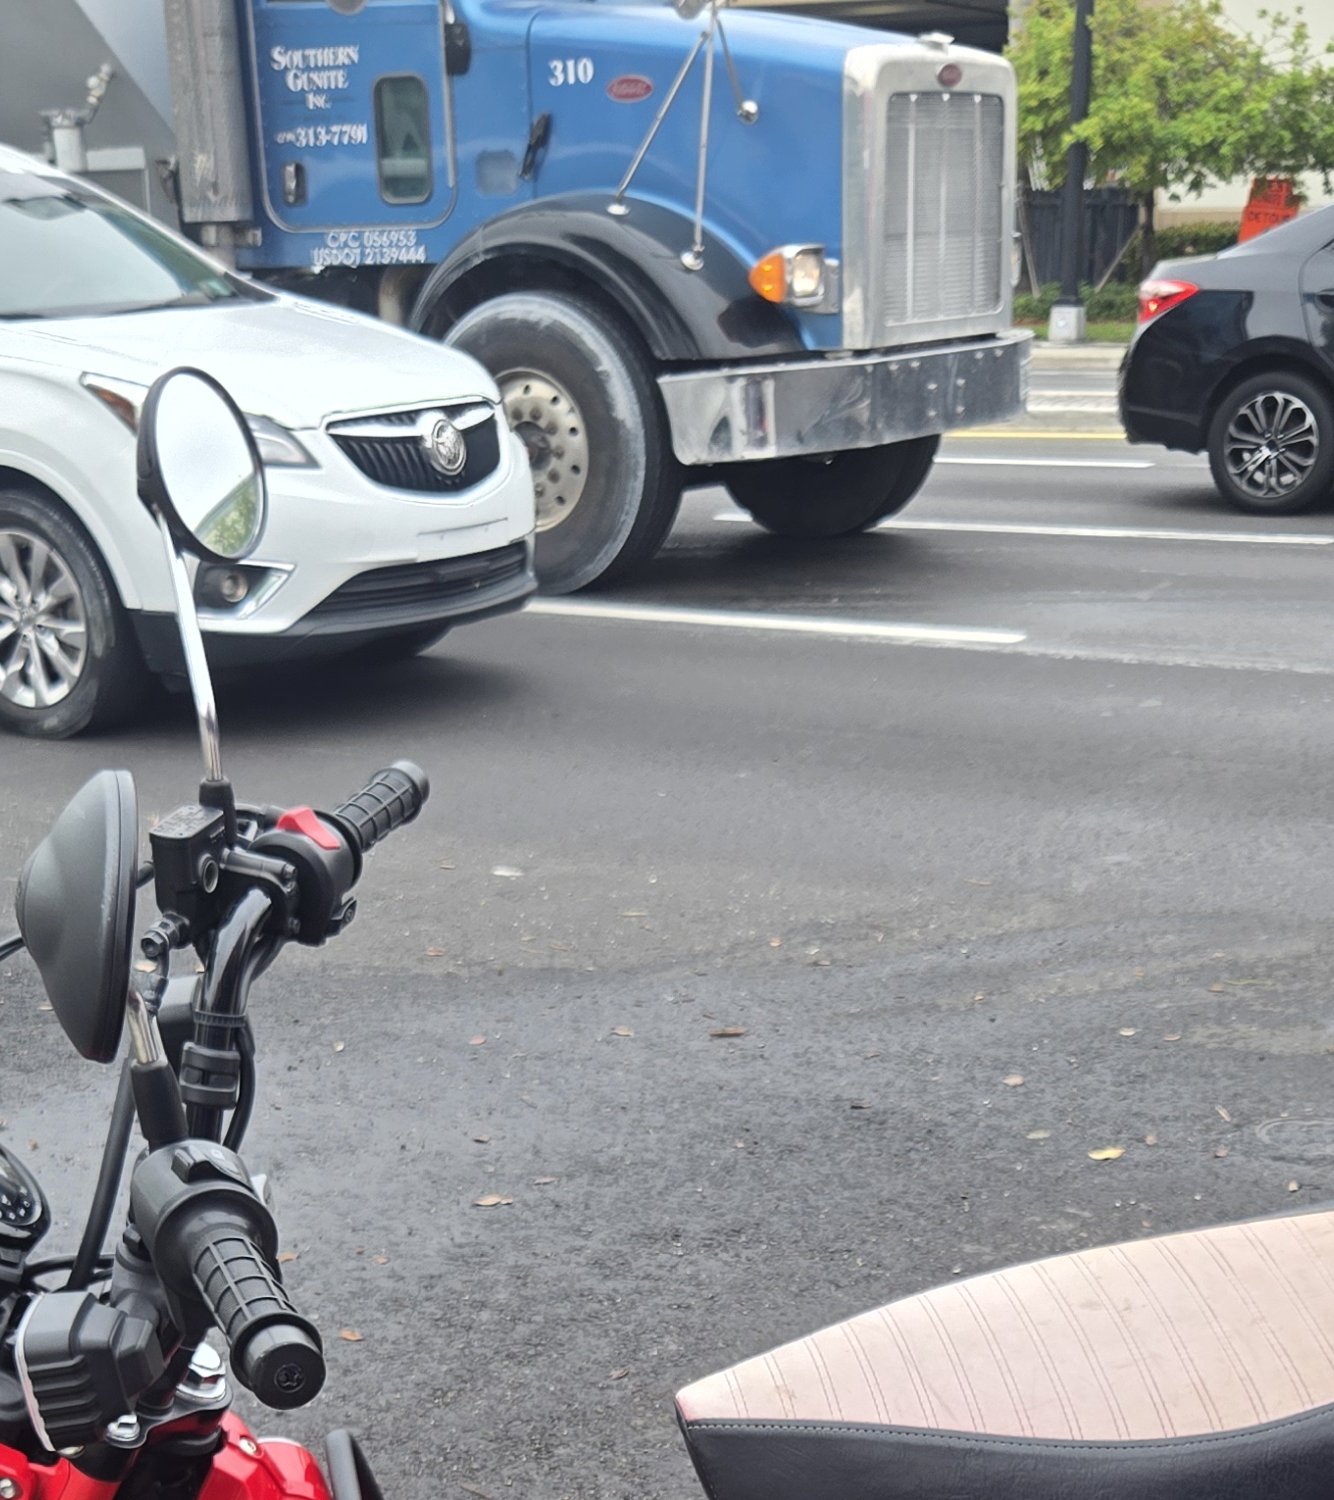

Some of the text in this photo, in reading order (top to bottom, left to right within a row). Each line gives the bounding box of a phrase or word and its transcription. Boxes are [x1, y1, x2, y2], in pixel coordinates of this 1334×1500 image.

[270, 45, 359, 71] SOUTHERN
[286, 68, 349, 92] GUNITE
[548, 58, 594, 87] 310
[326, 232, 360, 248] CPC
[313, 247, 360, 267] USDOT
